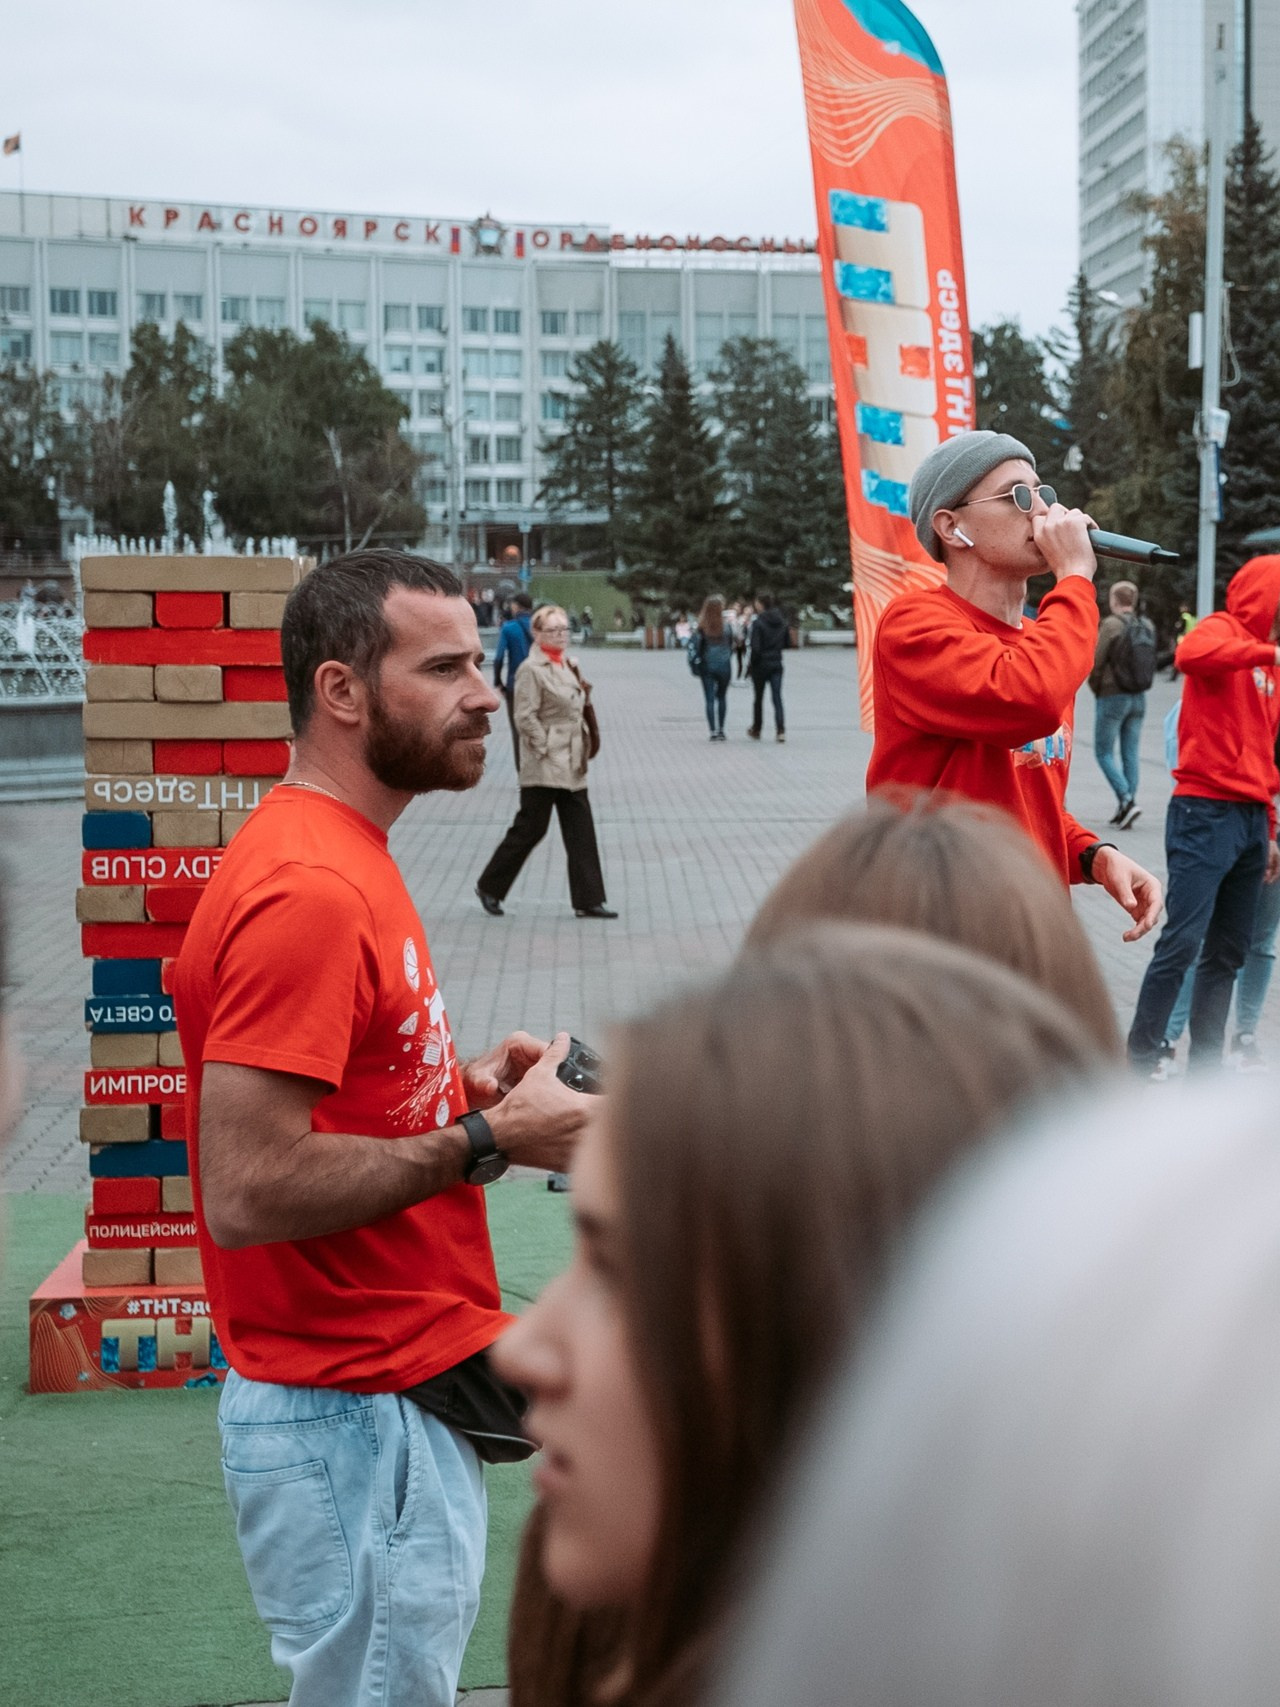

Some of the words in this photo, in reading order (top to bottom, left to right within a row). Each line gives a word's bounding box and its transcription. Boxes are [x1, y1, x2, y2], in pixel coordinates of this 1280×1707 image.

[129, 206, 440, 245] КРАСНОЯРСК
[532, 229, 819, 254] ОРДЕНОНОСНЫ
[91, 856, 166, 880] CLUB
[89, 1006, 154, 1024] СВЕТА
[159, 1005, 178, 1022] О
[102, 1316, 230, 1373] ТН
